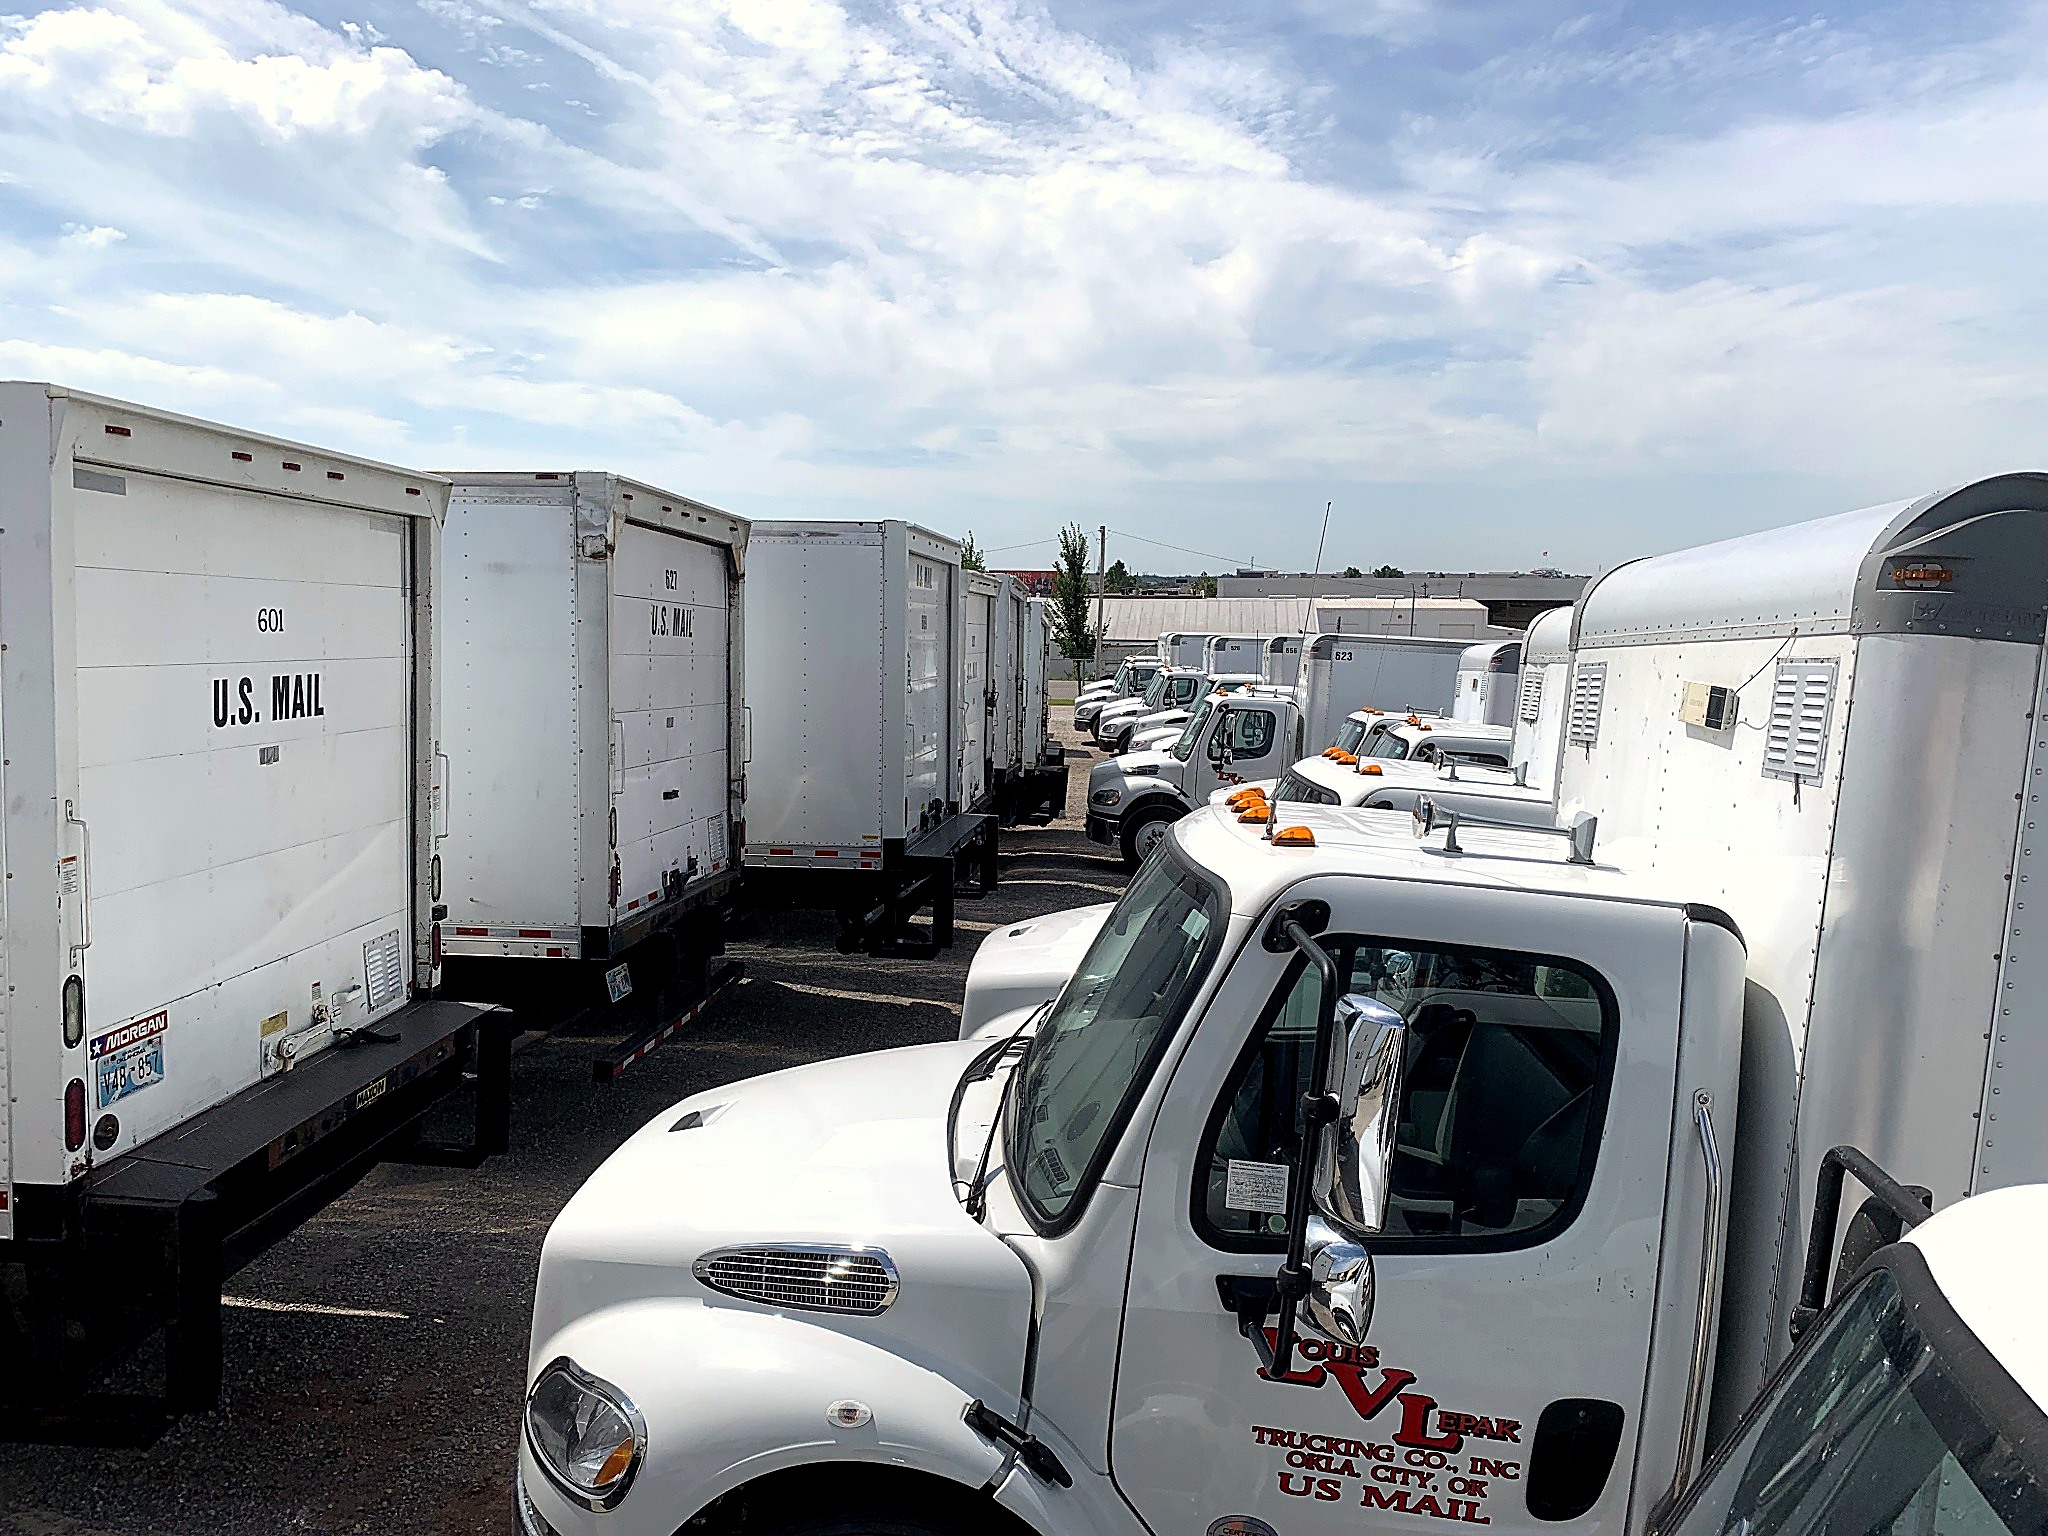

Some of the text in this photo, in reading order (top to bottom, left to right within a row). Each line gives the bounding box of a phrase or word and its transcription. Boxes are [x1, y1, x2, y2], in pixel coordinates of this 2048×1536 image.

[665, 569, 678, 590] 627
[257, 608, 284, 632] 601
[651, 604, 693, 638] U.S. MAIL
[1335, 651, 1353, 661] 623
[213, 673, 325, 728] U.S. MAIL
[105, 1014, 166, 1051] MORGAN
[1322, 1361, 1417, 1421] V
[1392, 1392, 1522, 1454] LEPAK
[1251, 1425, 1396, 1463] TRUCKING
[1469, 1456, 1521, 1480] INC
[1285, 1450, 1362, 1479] OKLA.
[1447, 1476, 1489, 1499] OK
[1277, 1471, 1491, 1526] US MAIL
